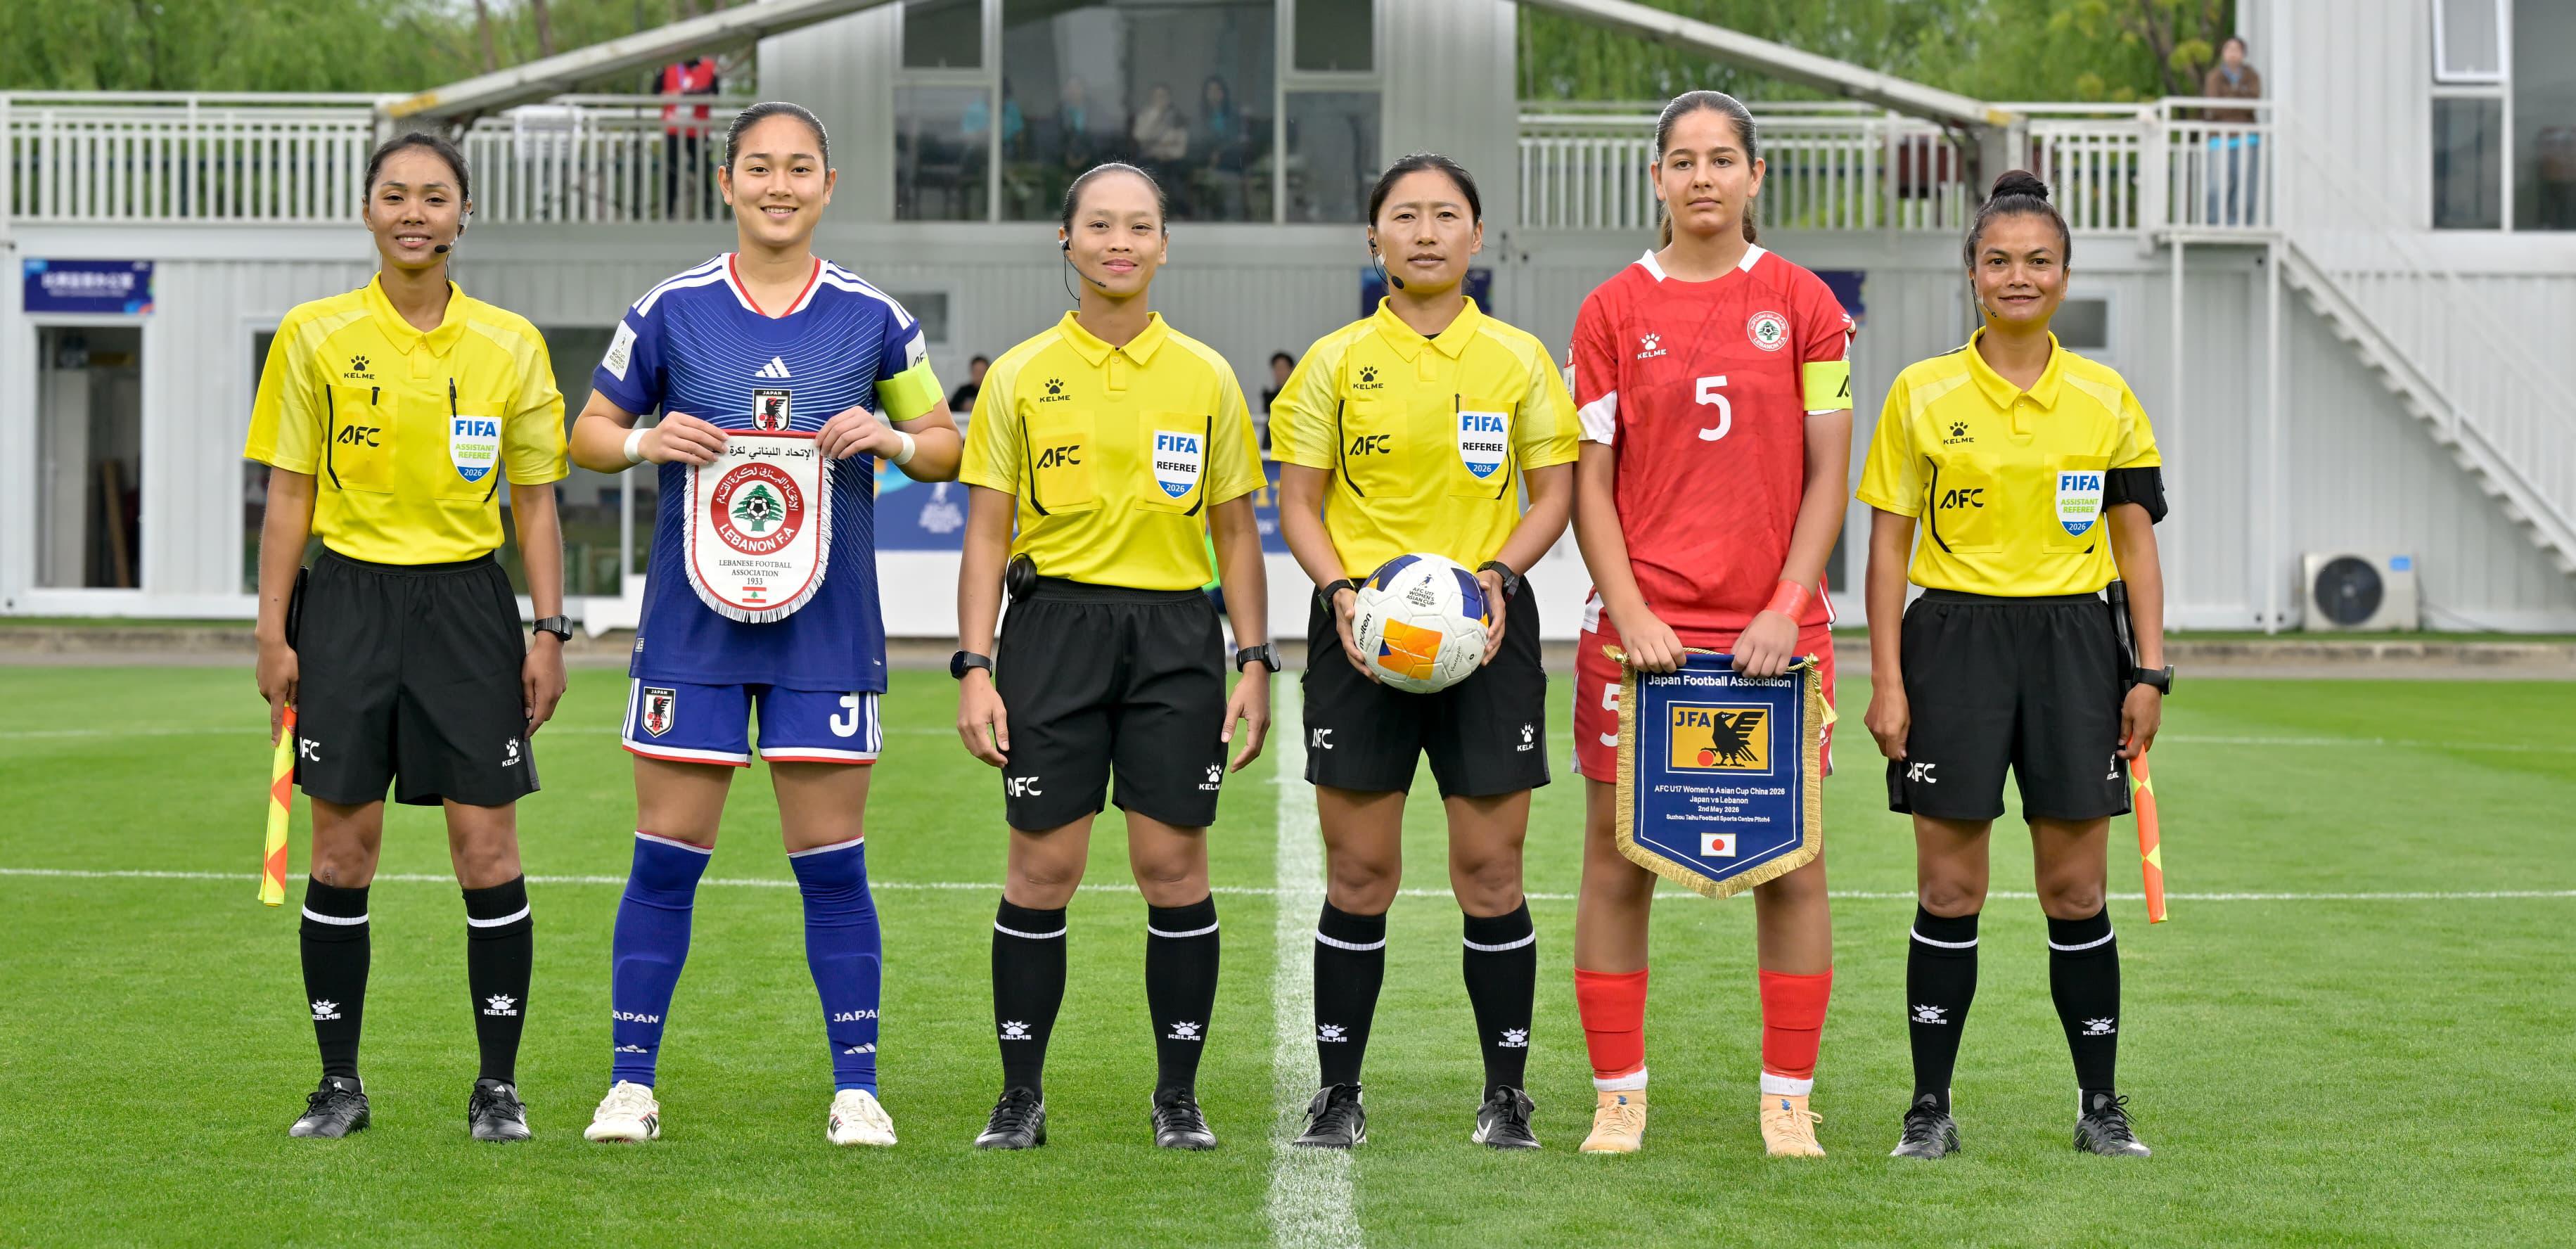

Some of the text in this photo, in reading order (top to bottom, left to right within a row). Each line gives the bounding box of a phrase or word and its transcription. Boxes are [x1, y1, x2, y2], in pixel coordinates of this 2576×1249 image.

[913, 350, 926, 367] AF
[1637, 349, 1667, 360] KELME
[1039, 395, 1071, 403] KELME
[1695, 375, 1731, 442] 5
[455, 420, 496, 437] FIFA
[1462, 415, 1504, 433] FIFA
[336, 425, 382, 447] AFC
[456, 443, 495, 451] ASSISTANT
[729, 446, 745, 456] لكرة
[1158, 435, 1198, 454] FIFA
[1349, 434, 1391, 456] AFC
[1462, 442, 1503, 452] REFEREE
[749, 447, 781, 459] اللبناني
[1036, 444, 1081, 470] AFC
[463, 468, 482, 477] 2026
[1156, 461, 1197, 473] REFEREE
[1473, 464, 1492, 473] 2026
[1166, 483, 1185, 493] 2026
[2061, 475, 2100, 491] FIFA
[1940, 488, 1985, 509] AFC
[719, 523, 795, 552] LEBANON F.A
[1359, 613, 1372, 650] molten
[1648, 674, 1791, 688] Japan Football Association
[1674, 711, 1711, 727] JFA
[1312, 728, 1334, 750] AFC
[300, 736, 321, 762] FC
[1654, 784, 1670, 793] AFC
[1736, 787, 1749, 796] Cup
[1689, 795, 1710, 804] Japan
[613, 1009, 659, 1023] APAN
[1912, 1016, 1947, 1025] KELME
[1168, 1033, 1201, 1042] KELME
[2082, 1027, 2116, 1036] KELME
[1316, 1035, 1347, 1043] KELME
